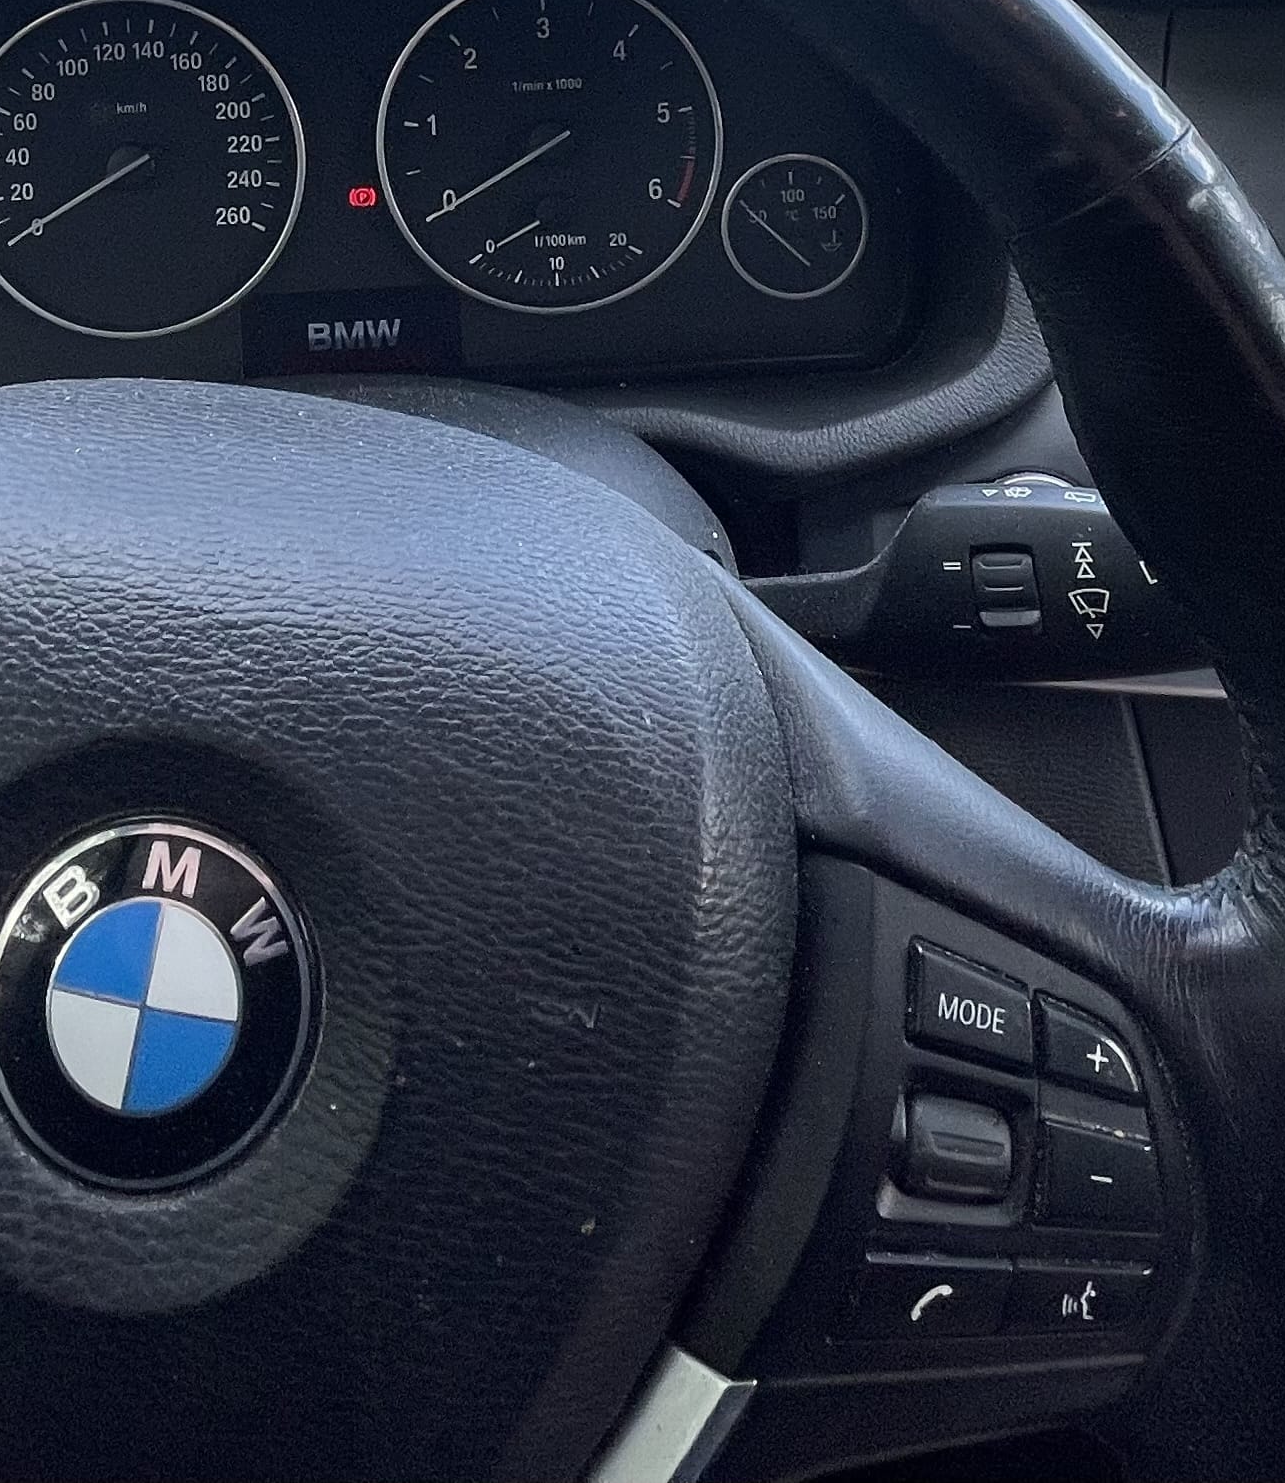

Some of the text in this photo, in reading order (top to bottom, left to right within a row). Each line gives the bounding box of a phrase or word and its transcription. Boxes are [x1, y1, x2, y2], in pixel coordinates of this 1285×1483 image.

[536, 18, 550, 38] 3
[93, 44, 125, 61] 120
[132, 41, 164, 58] 140
[464, 48, 478, 69] 2
[613, 40, 627, 61] 4
[58, 59, 89, 76] 100
[170, 53, 202, 70] 160
[31, 84, 55, 100] 80
[198, 74, 229, 92] 180
[116, 102, 147, 114] km/h
[215, 102, 251, 119] 200
[657, 102, 670, 123] 5
[14, 113, 37, 131] 60
[427, 114, 437, 135] 1
[227, 135, 263, 153] 220
[5, 149, 29, 166] 40
[227, 170, 263, 188] 240
[10, 183, 34, 201] 20
[648, 178, 662, 199] 6
[781, 189, 805, 203] 100
[215, 207, 251, 225] 260
[813, 206, 837, 219] 150
[485, 240, 495, 253] 0
[609, 233, 627, 246] 20
[549, 257, 564, 270] 10
[308, 319, 401, 351] BMW
[42, 840, 289, 967] BMW
[938, 992, 1006, 1035] MODE
